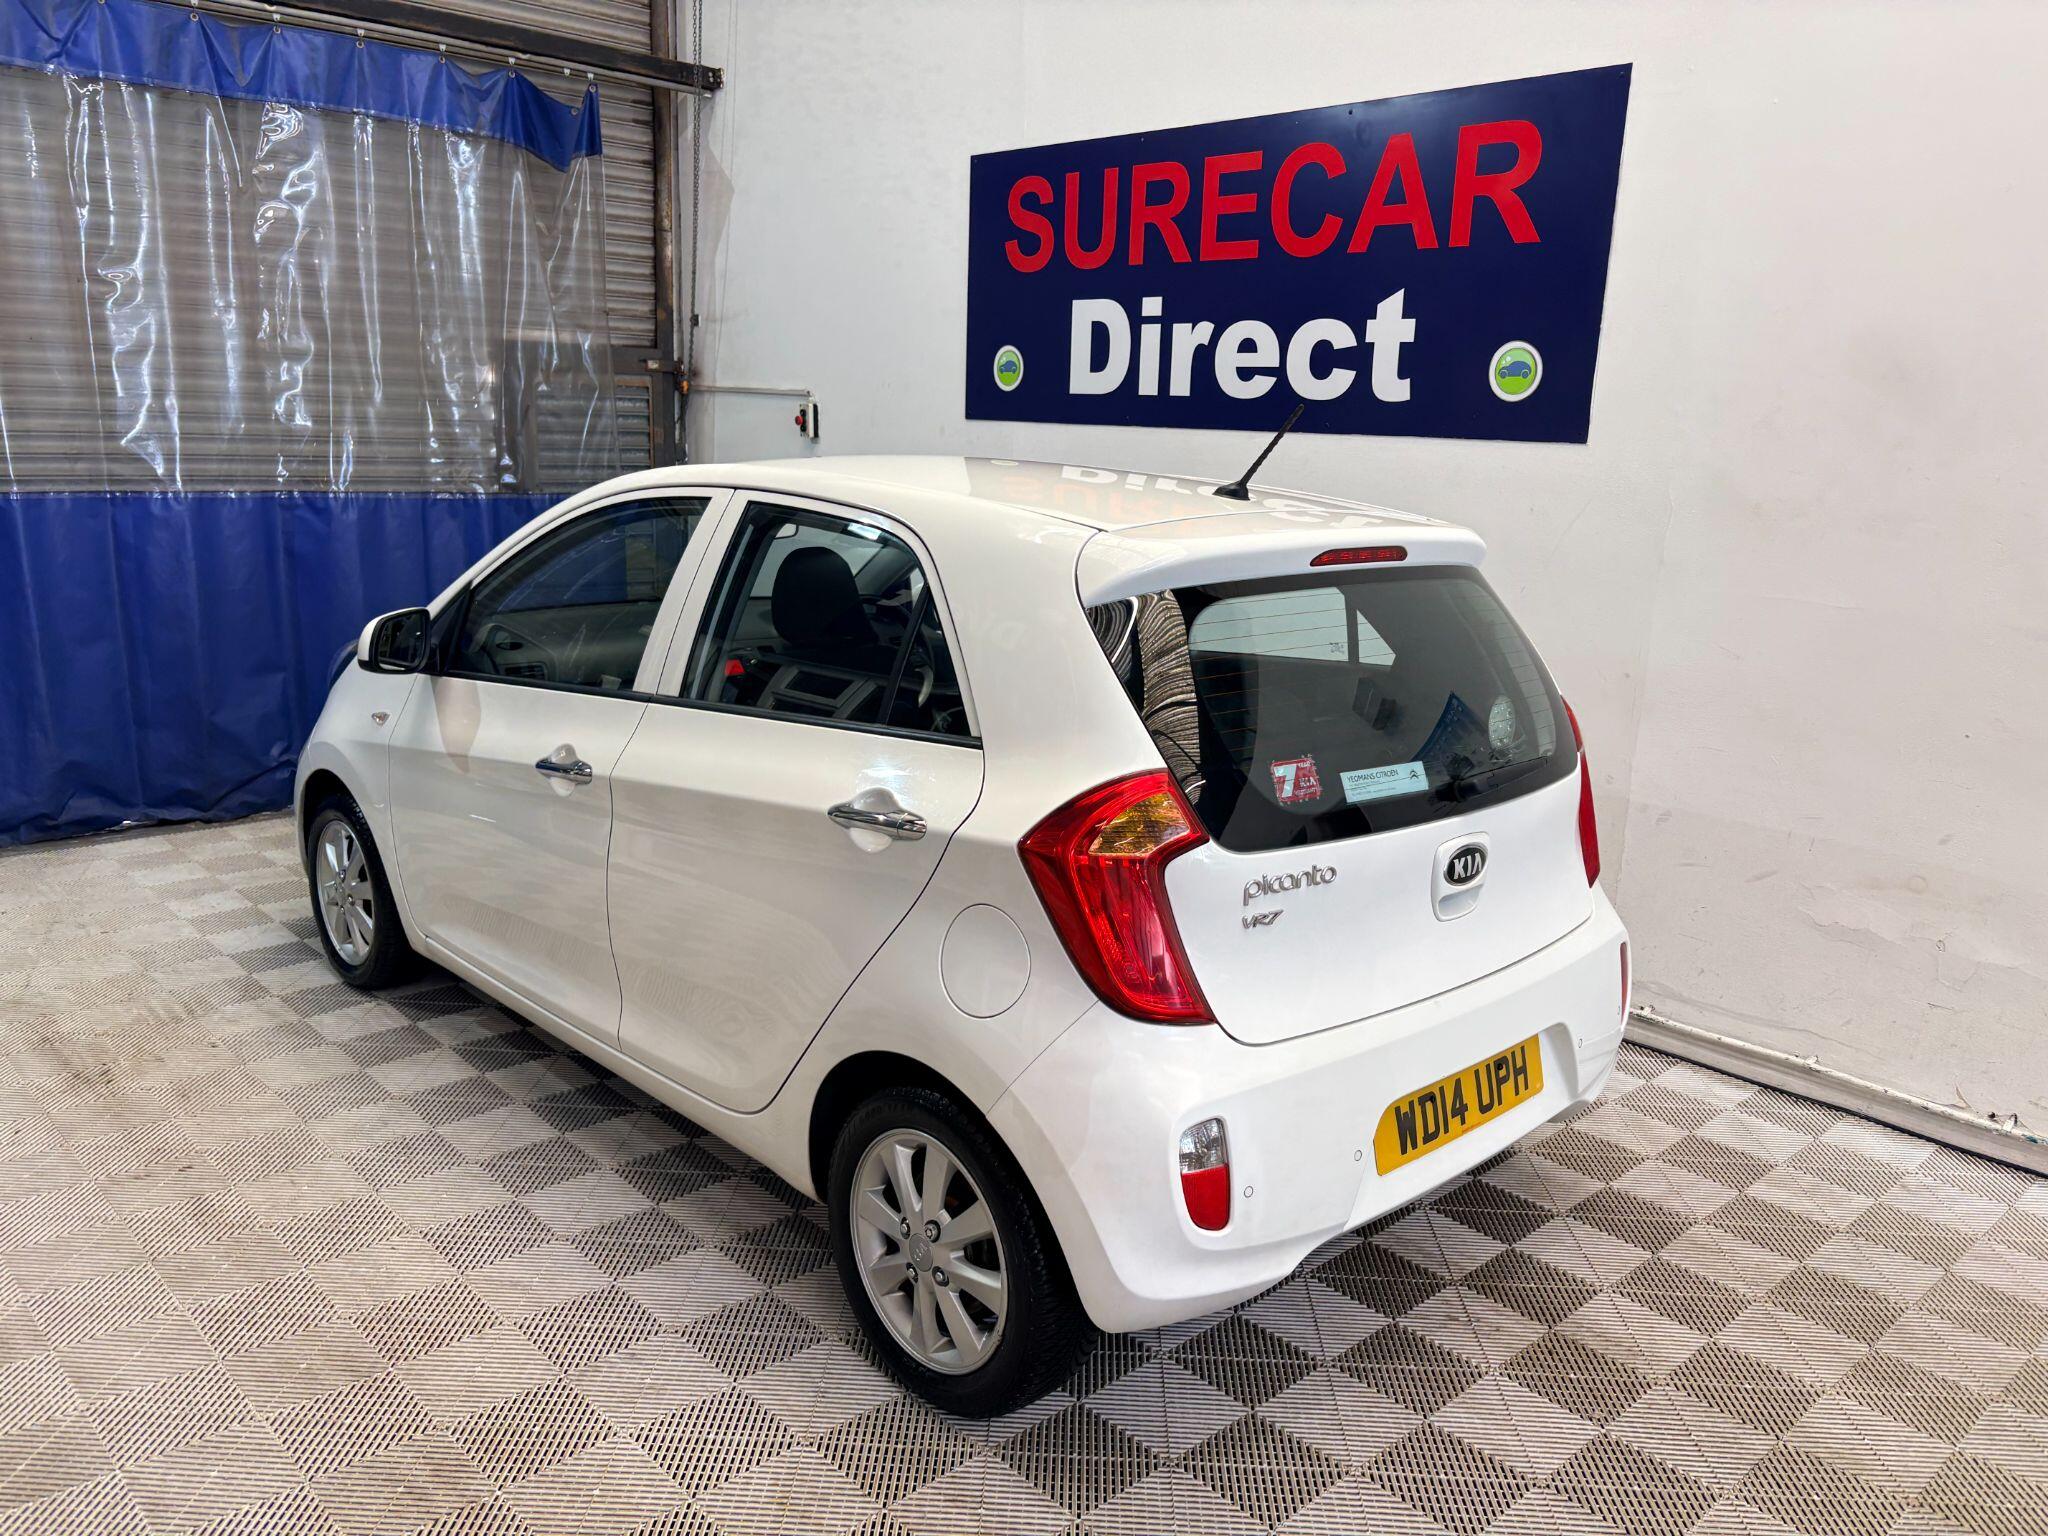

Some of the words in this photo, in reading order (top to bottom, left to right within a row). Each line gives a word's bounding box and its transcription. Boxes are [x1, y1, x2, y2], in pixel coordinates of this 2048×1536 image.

[1005, 120, 1543, 272] SURECAR
[1068, 288, 1417, 402] Direct
[1273, 763, 1297, 798] 7
[1347, 772, 1376, 784] YEOMANS
[1243, 864, 1338, 906] picanto
[1453, 852, 1482, 881] KIA
[1242, 909, 1285, 930] VR7
[1394, 1077, 1469, 1156] WD14
[1473, 1045, 1529, 1116] UPH
